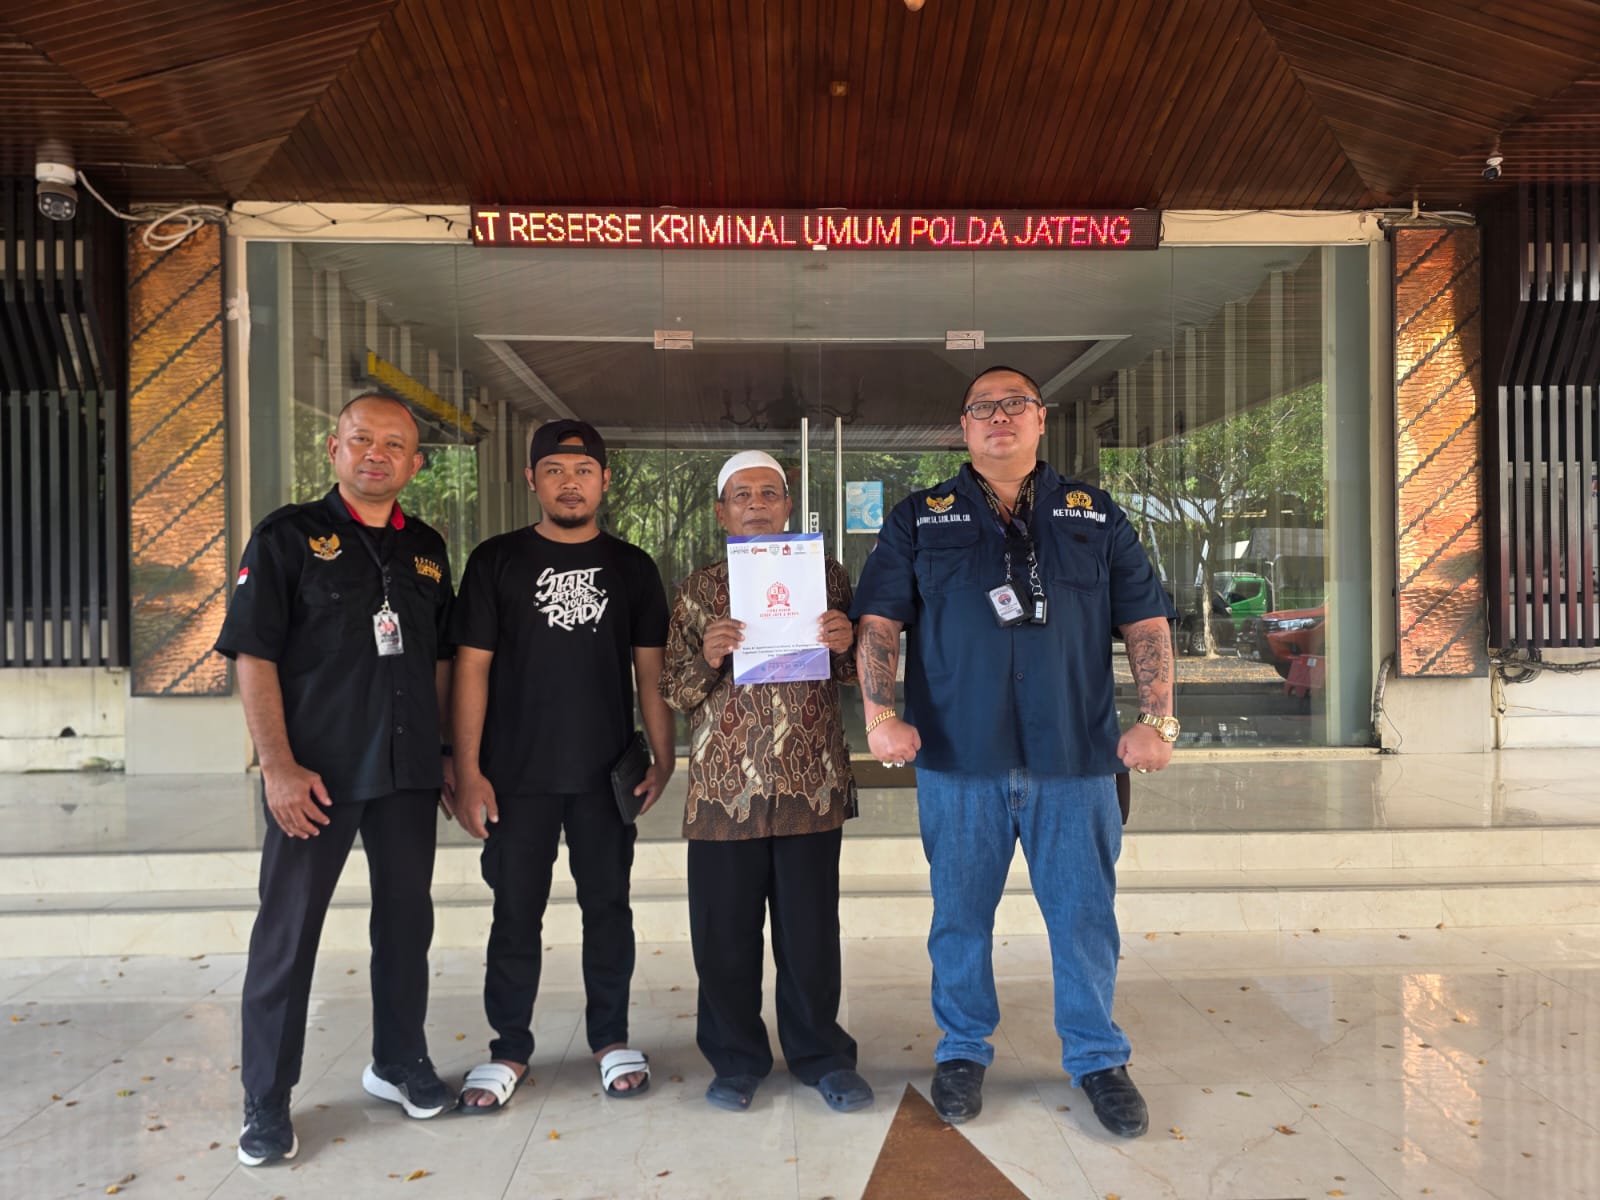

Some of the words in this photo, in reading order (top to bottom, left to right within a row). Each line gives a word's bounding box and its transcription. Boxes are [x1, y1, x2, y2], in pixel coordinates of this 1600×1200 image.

[508, 211, 642, 243] RESERSE
[650, 213, 797, 245] KRIMINAL
[804, 215, 901, 245] UMUM
[911, 216, 1009, 245] POLDA
[1014, 216, 1132, 246] JATENG
[1052, 508, 1082, 518] KETUA
[1083, 510, 1107, 523] UMUM
[535, 567, 604, 602] START
[549, 588, 594, 605] BEFORE
[538, 597, 609, 631] READY
